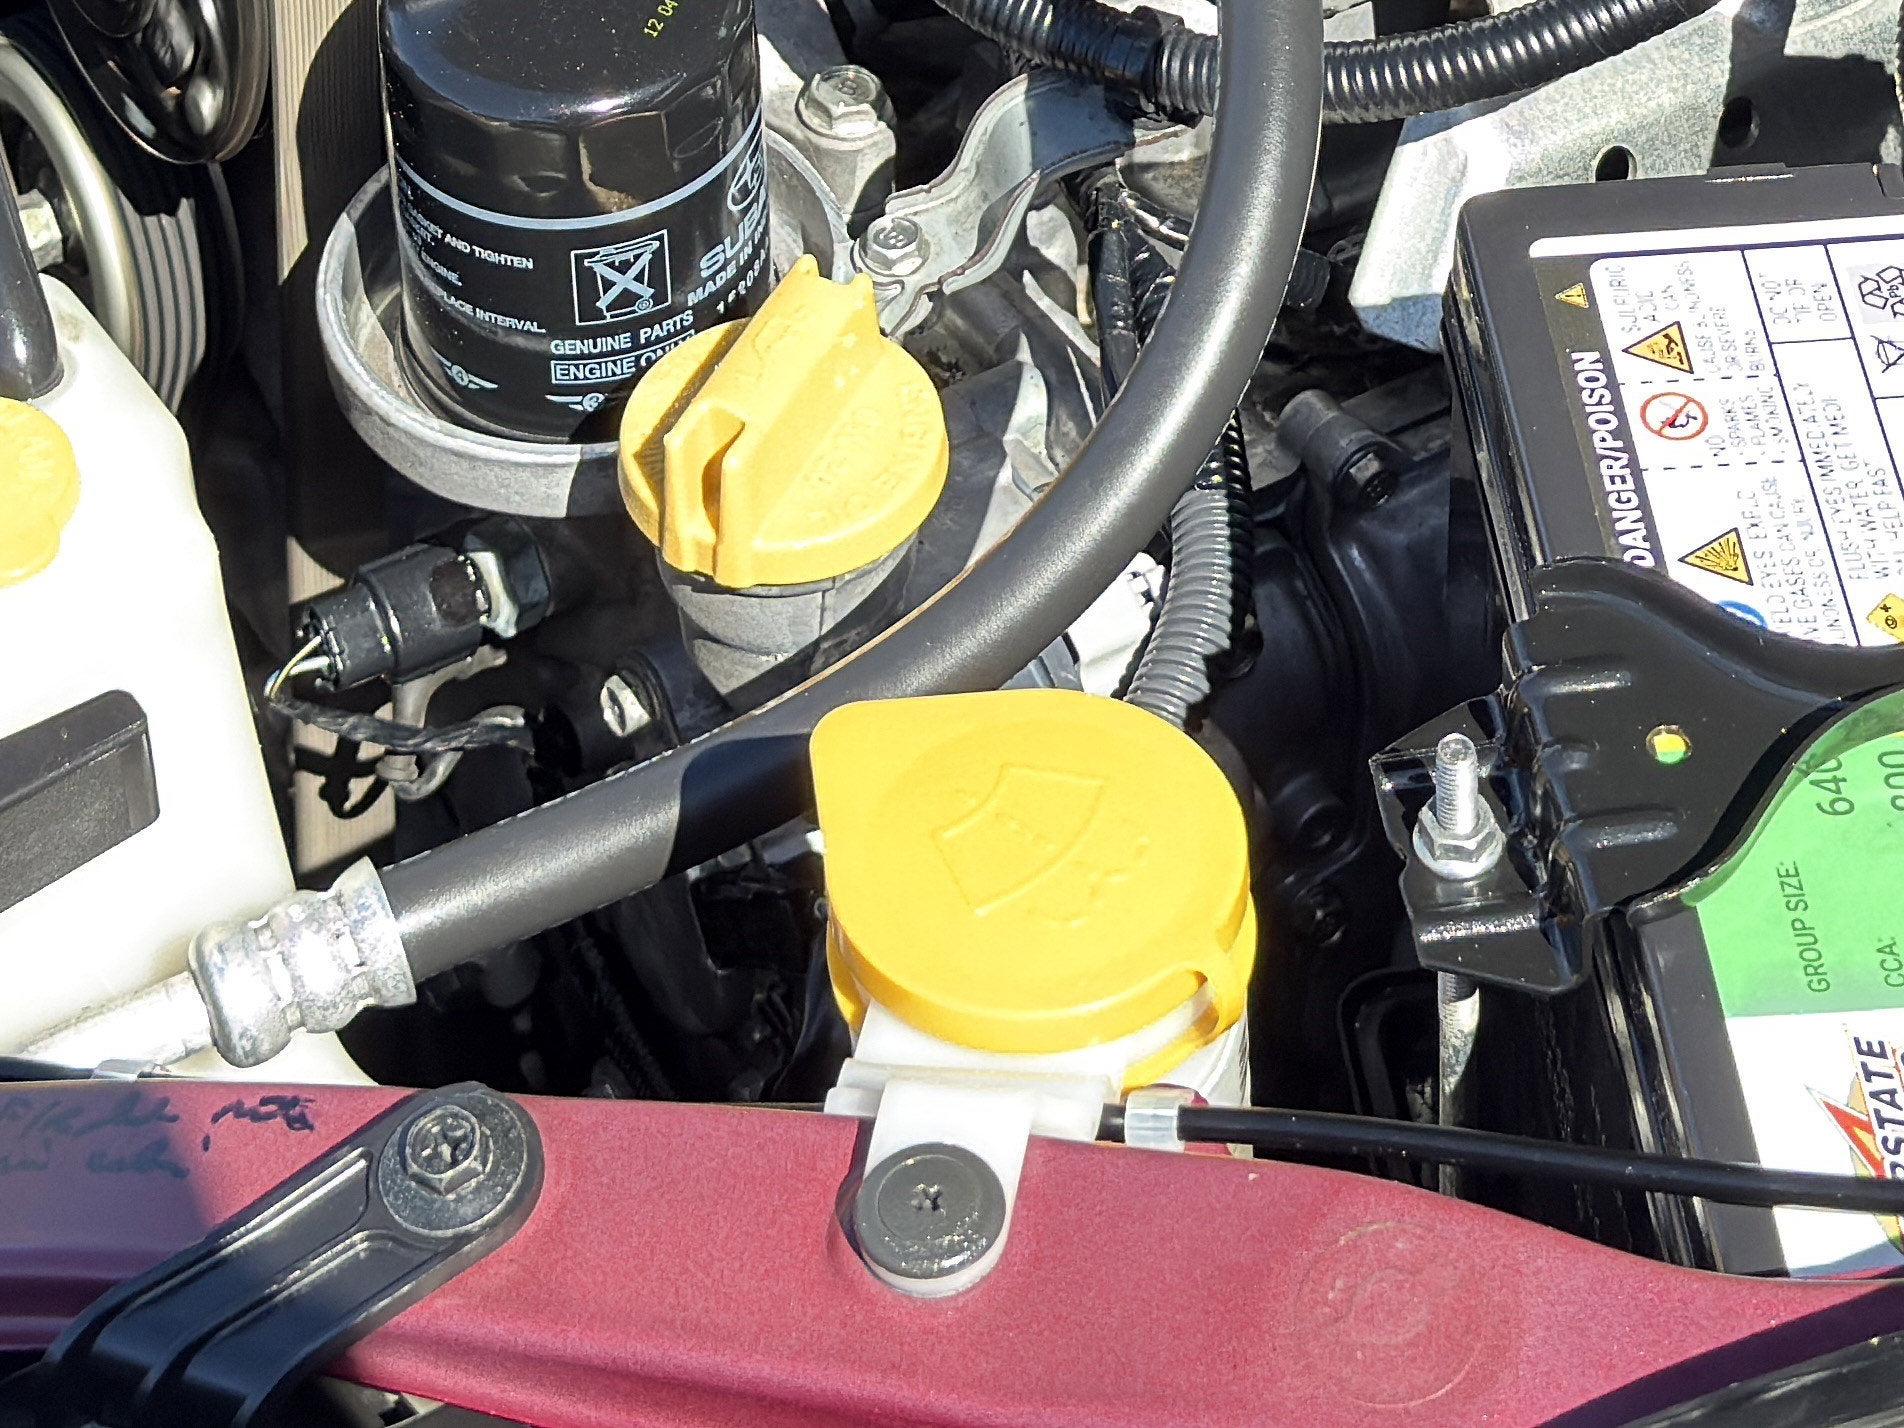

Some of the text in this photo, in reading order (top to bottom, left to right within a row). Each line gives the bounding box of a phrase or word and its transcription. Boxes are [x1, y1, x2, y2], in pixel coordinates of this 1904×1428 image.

[640, 14, 666, 39] 12
[443, 233, 534, 270] AND TIGHTEN
[699, 185, 768, 279] SUBA
[686, 240, 753, 307] MADE IN
[1885, 283, 1903, 298] Pb
[474, 302, 546, 334] INTERVAL.
[550, 309, 695, 353] GENUINE PARTS
[556, 356, 637, 383] ENGINE
[1568, 349, 1658, 569] DANGER/POISON
[1772, 860, 1834, 992] GROUP SIZE:
